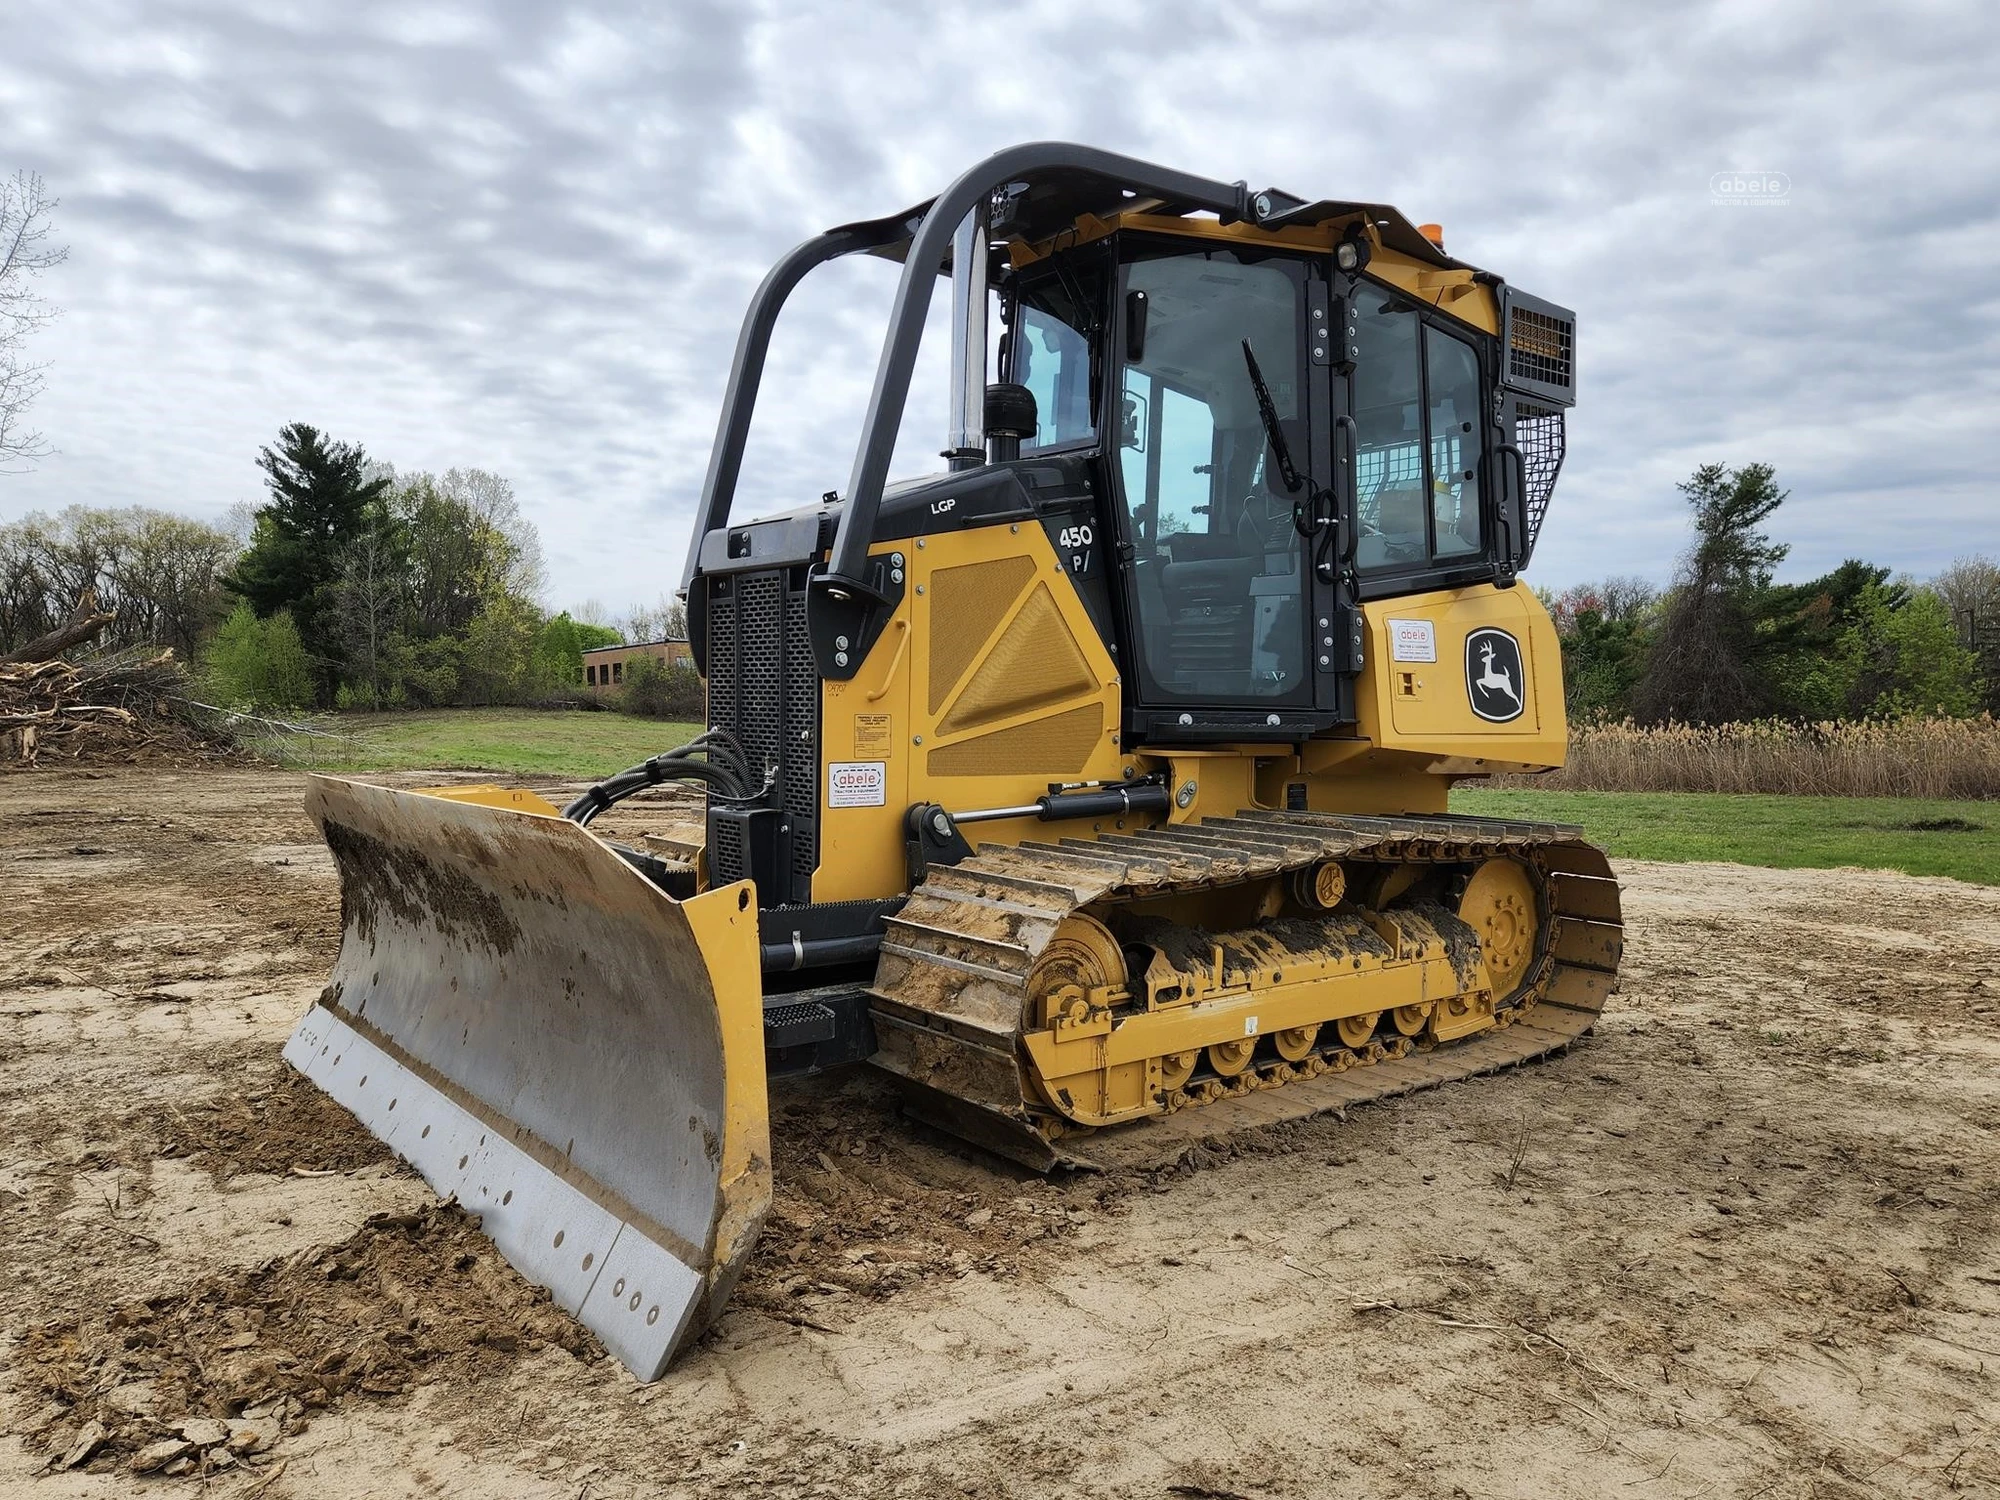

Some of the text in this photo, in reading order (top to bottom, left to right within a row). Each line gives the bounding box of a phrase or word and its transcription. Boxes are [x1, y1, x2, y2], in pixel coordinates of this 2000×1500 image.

[930, 498, 956, 515] LGP
[1059, 525, 1093, 549] 450
[1401, 629, 1426, 640] abele
[839, 773, 875, 785] abele
